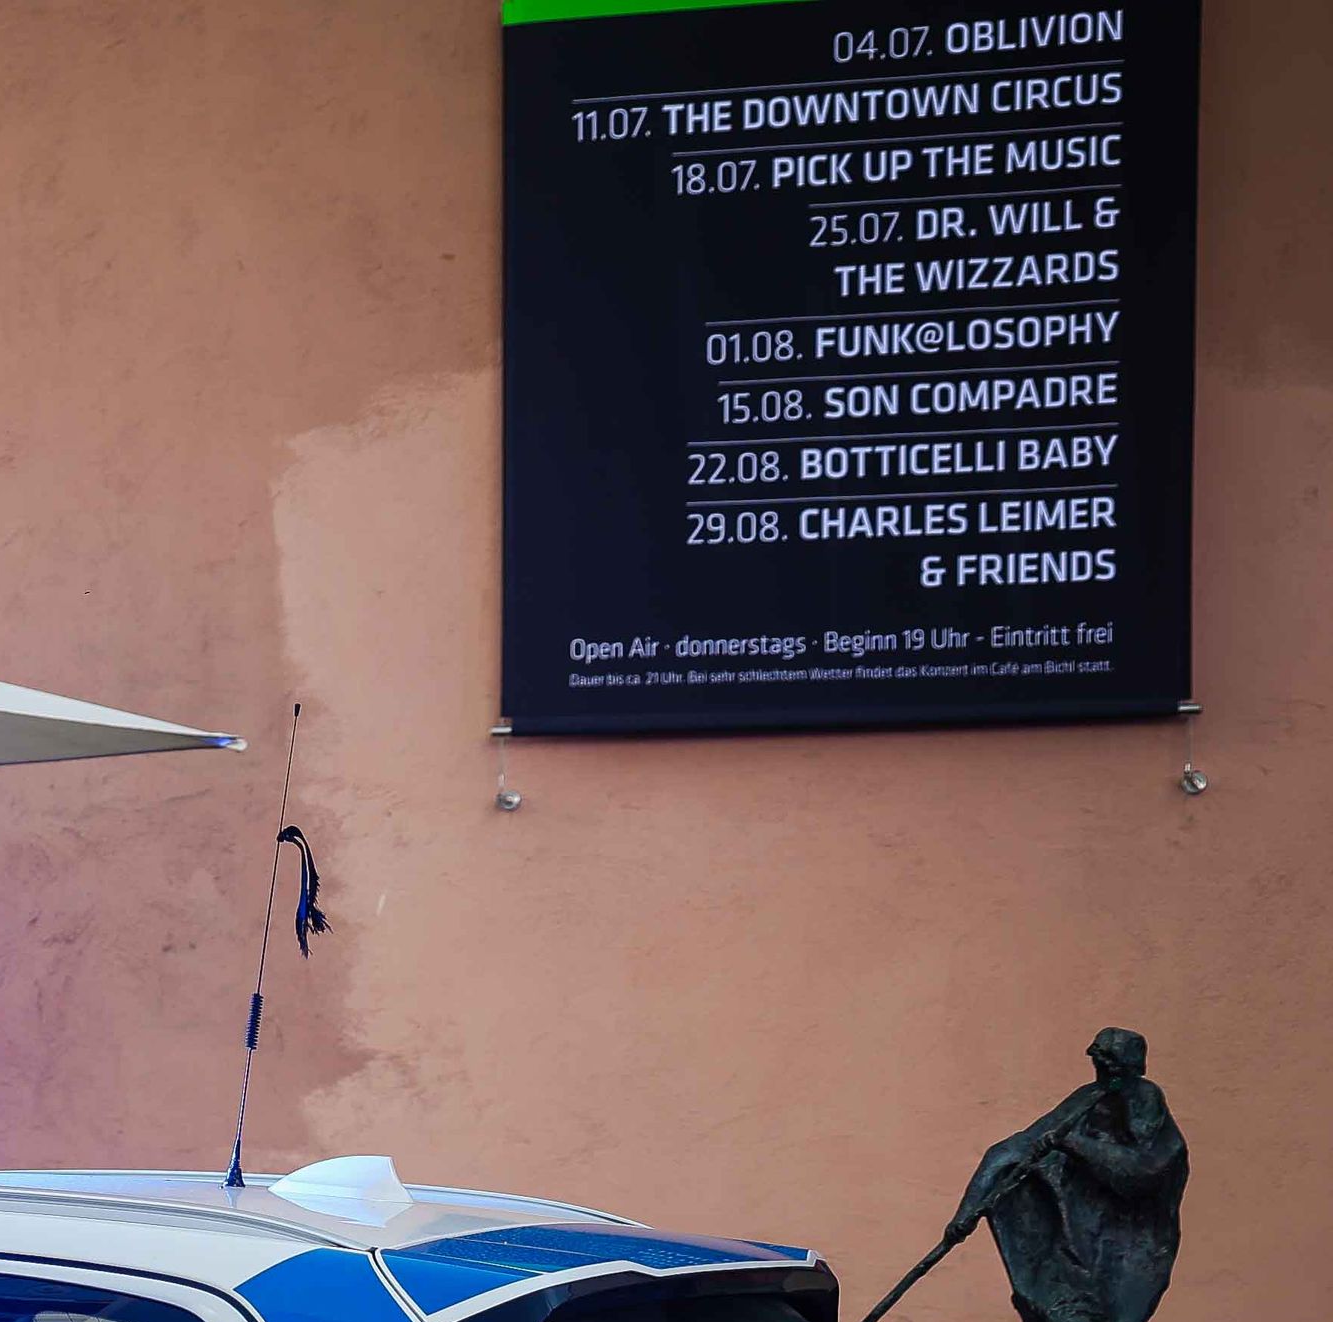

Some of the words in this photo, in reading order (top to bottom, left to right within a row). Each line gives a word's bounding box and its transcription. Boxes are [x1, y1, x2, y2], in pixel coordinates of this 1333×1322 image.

[835, 26, 932, 62] 04.07.
[947, 10, 1122, 53] OBLIVION
[572, 107, 650, 141] 11.07.
[662, 101, 731, 134] THE
[744, 83, 978, 129] DOWNTOWN
[993, 69, 1121, 111] CIRCUS
[672, 160, 759, 194] 18.07.
[773, 153, 852, 187] PICK
[865, 150, 912, 181] UP
[922, 144, 993, 177] THE
[1006, 135, 1120, 173] MUSIC
[810, 212, 902, 246] 25.07.
[917, 208, 976, 240] DR.
[989, 200, 1082, 235] WILL
[1095, 197, 1119, 227] &
[834, 263, 904, 296] THE
[916, 250, 1118, 291] WIZZARDS
[707, 330, 802, 365] 01.08.
[814, 311, 1119, 358] FUNK@LOSOPHY
[718, 390, 811, 423] 15.08.
[825, 385, 898, 418] SON
[911, 373, 1117, 414] COMPADRE
[688, 451, 788, 484] 22.08.
[801, 441, 1005, 479] BOTTICELLI
[1019, 435, 1118, 470] BABY
[688, 511, 787, 544] 29.08.
[800, 503, 967, 539] CHARLES
[979, 497, 1116, 532] LEIMER
[921, 556, 946, 586] &
[958, 549, 1115, 586] FRIENDS
[569, 638, 624, 664] Open
[629, 636, 661, 659] Air
[675, 634, 807, 660] donnerstags
[824, 631, 897, 658] Beginn
[902, 628, 925, 650] 19
[931, 627, 970, 649] Uhr
[990, 624, 1071, 648] Eintritt
[1077, 621, 1114, 645] frei
